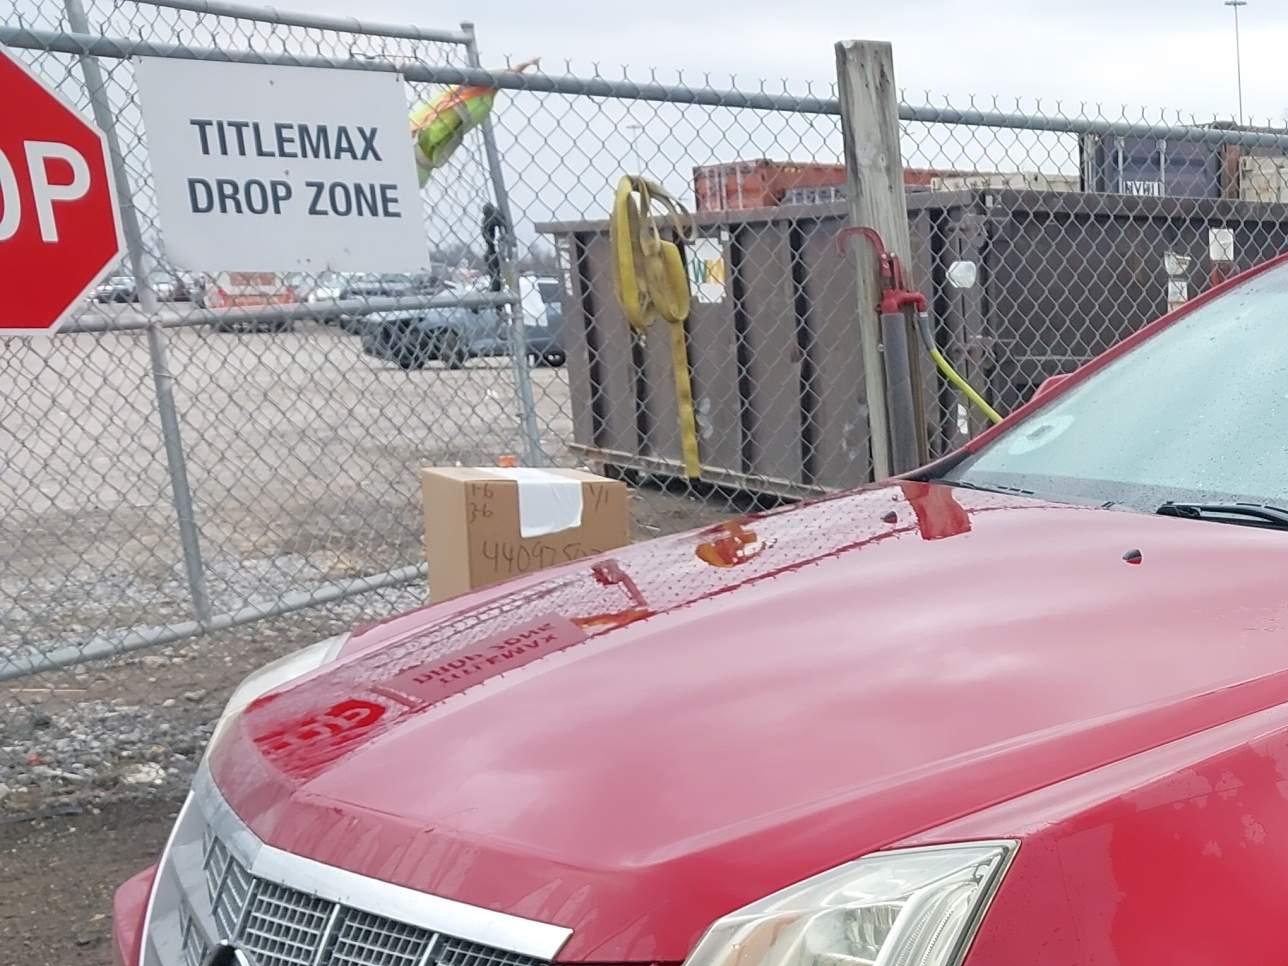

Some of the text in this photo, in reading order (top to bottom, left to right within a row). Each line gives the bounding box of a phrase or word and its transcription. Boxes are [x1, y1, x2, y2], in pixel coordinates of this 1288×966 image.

[189, 118, 383, 162] TITLEMAX
[187, 177, 402, 218] DROP ZONE
